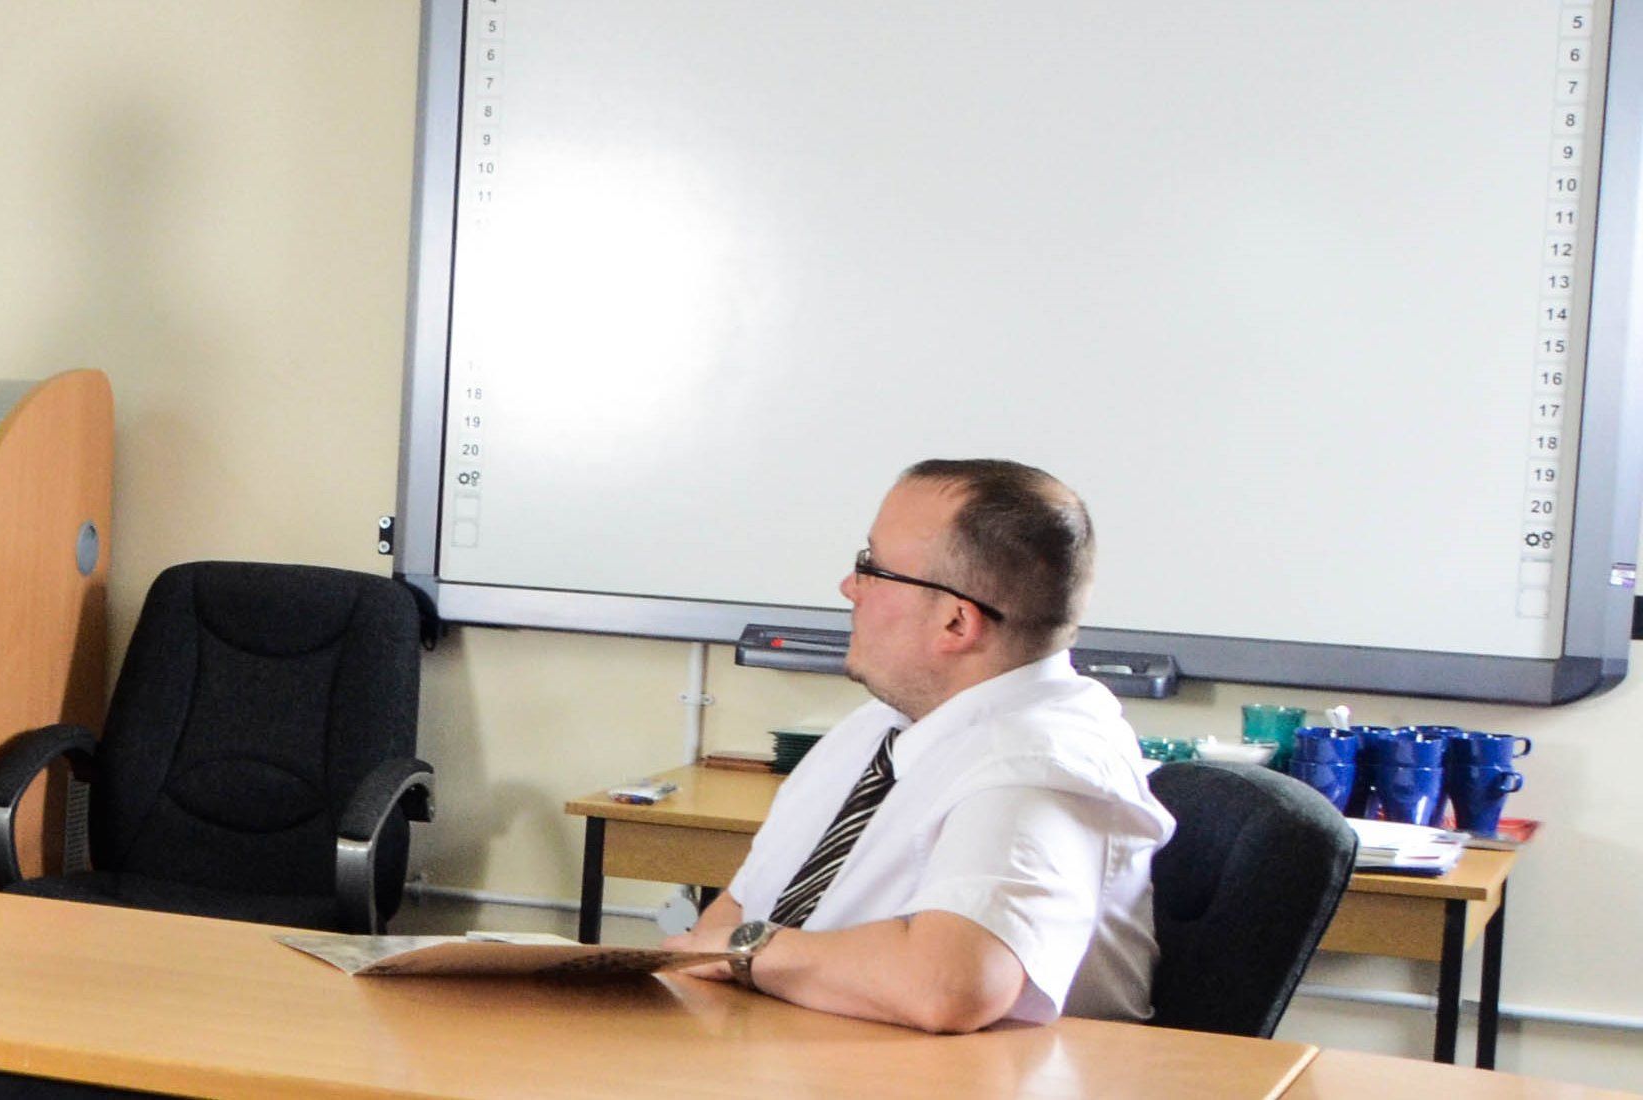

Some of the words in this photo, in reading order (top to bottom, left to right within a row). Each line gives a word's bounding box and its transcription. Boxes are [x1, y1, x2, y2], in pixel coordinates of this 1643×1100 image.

[488, 20, 497, 33] 5
[1572, 15, 1583, 29] 5
[486, 48, 496, 61] 6
[1570, 48, 1580, 62] 6
[485, 77, 494, 89] 7
[1568, 80, 1578, 94] 7
[483, 105, 493, 118] 8
[1565, 112, 1576, 127] 8
[482, 133, 491, 146] 9
[1563, 145, 1574, 159] 9
[478, 162, 494, 174] 10
[1556, 178, 1578, 192] 10
[1556, 211, 1574, 224] 11
[1552, 243, 1573, 257] 12
[1548, 274, 1571, 289] 13
[1547, 308, 1568, 321] 14
[1544, 339, 1566, 354] 15
[1542, 371, 1563, 386] 16
[1539, 404, 1561, 417] 17
[465, 416, 481, 428] 19
[462, 443, 479, 456] 20
[1537, 436, 1559, 451] 18
[1535, 468, 1556, 482] 19
[1530, 499, 1553, 515] 20
